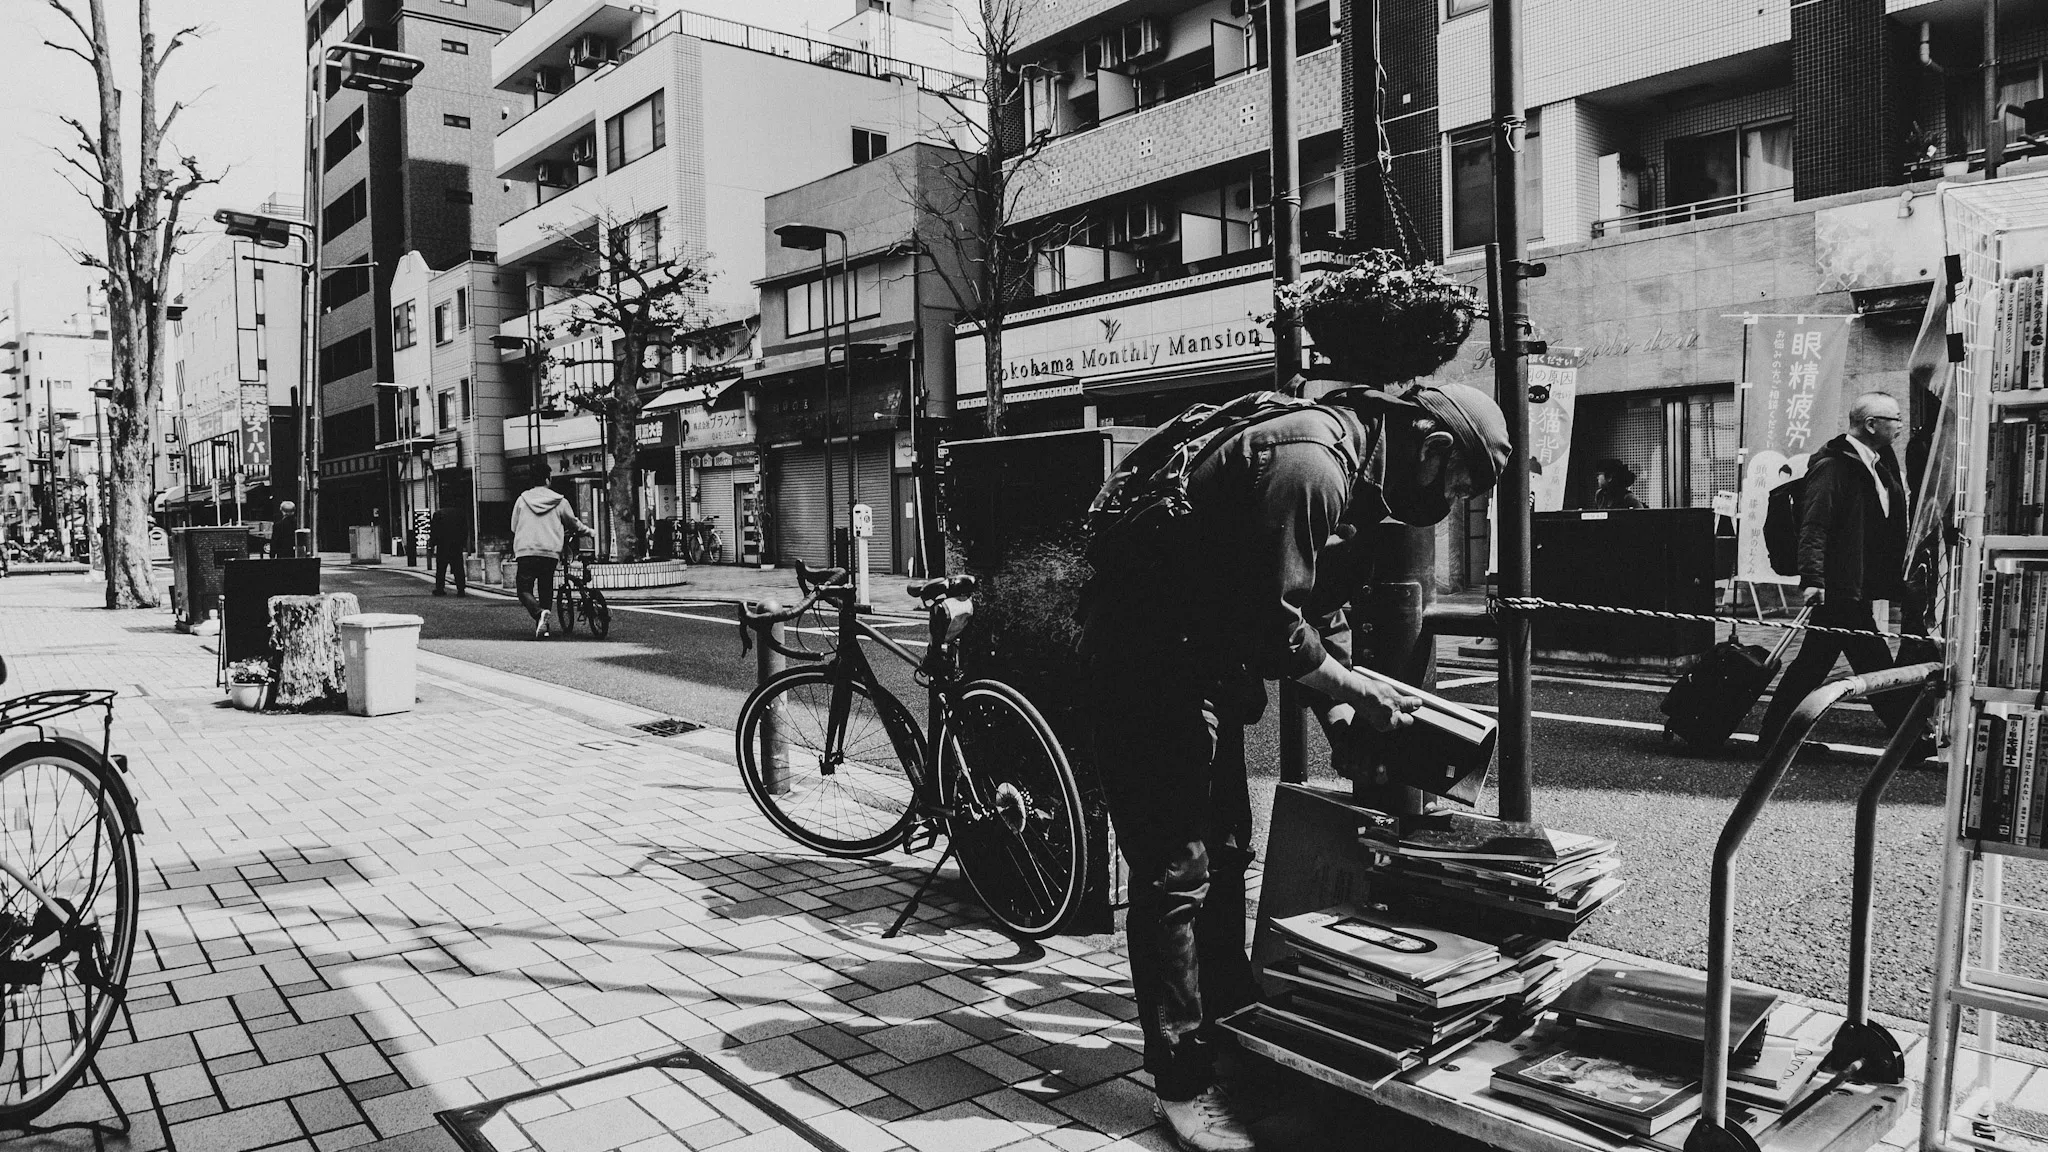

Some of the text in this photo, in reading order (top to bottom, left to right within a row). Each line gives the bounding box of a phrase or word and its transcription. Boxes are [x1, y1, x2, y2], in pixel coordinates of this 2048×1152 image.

[1000, 328, 1260, 381] okohama Monthly Mansion
[1786, 331, 1822, 449] 眼精疲労
[1536, 406, 1564, 464] 猫背
